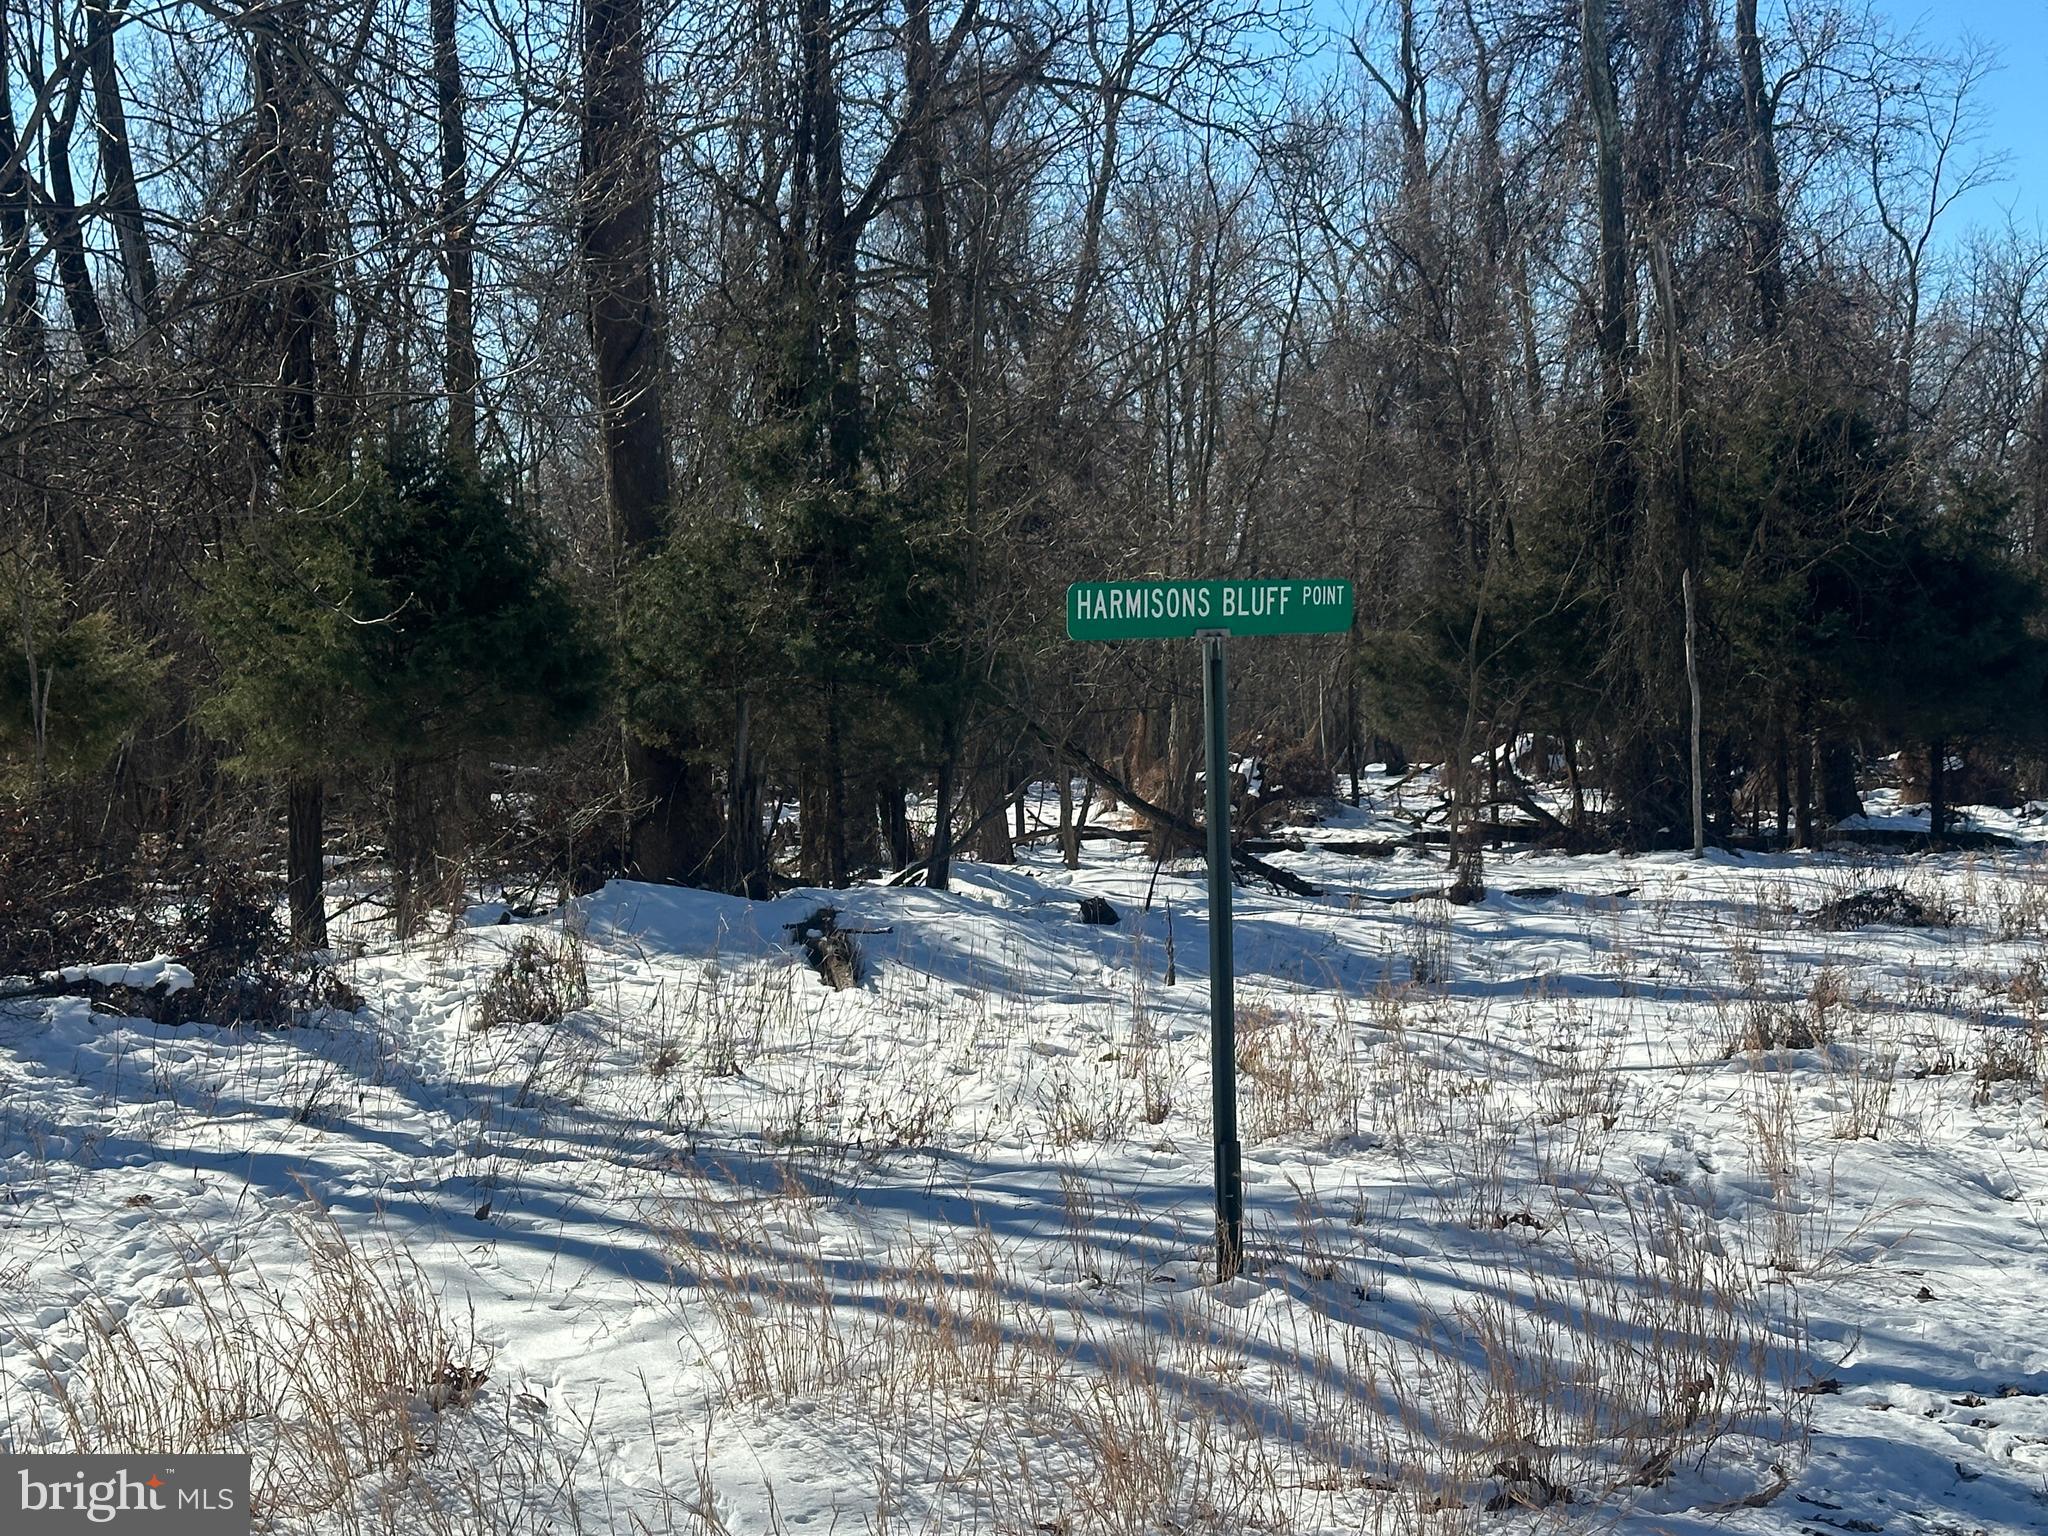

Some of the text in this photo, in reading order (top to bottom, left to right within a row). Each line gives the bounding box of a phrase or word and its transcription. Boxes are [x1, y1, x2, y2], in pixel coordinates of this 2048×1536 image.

[1077, 585, 1344, 619] HARMISONS BLUFF POINT
